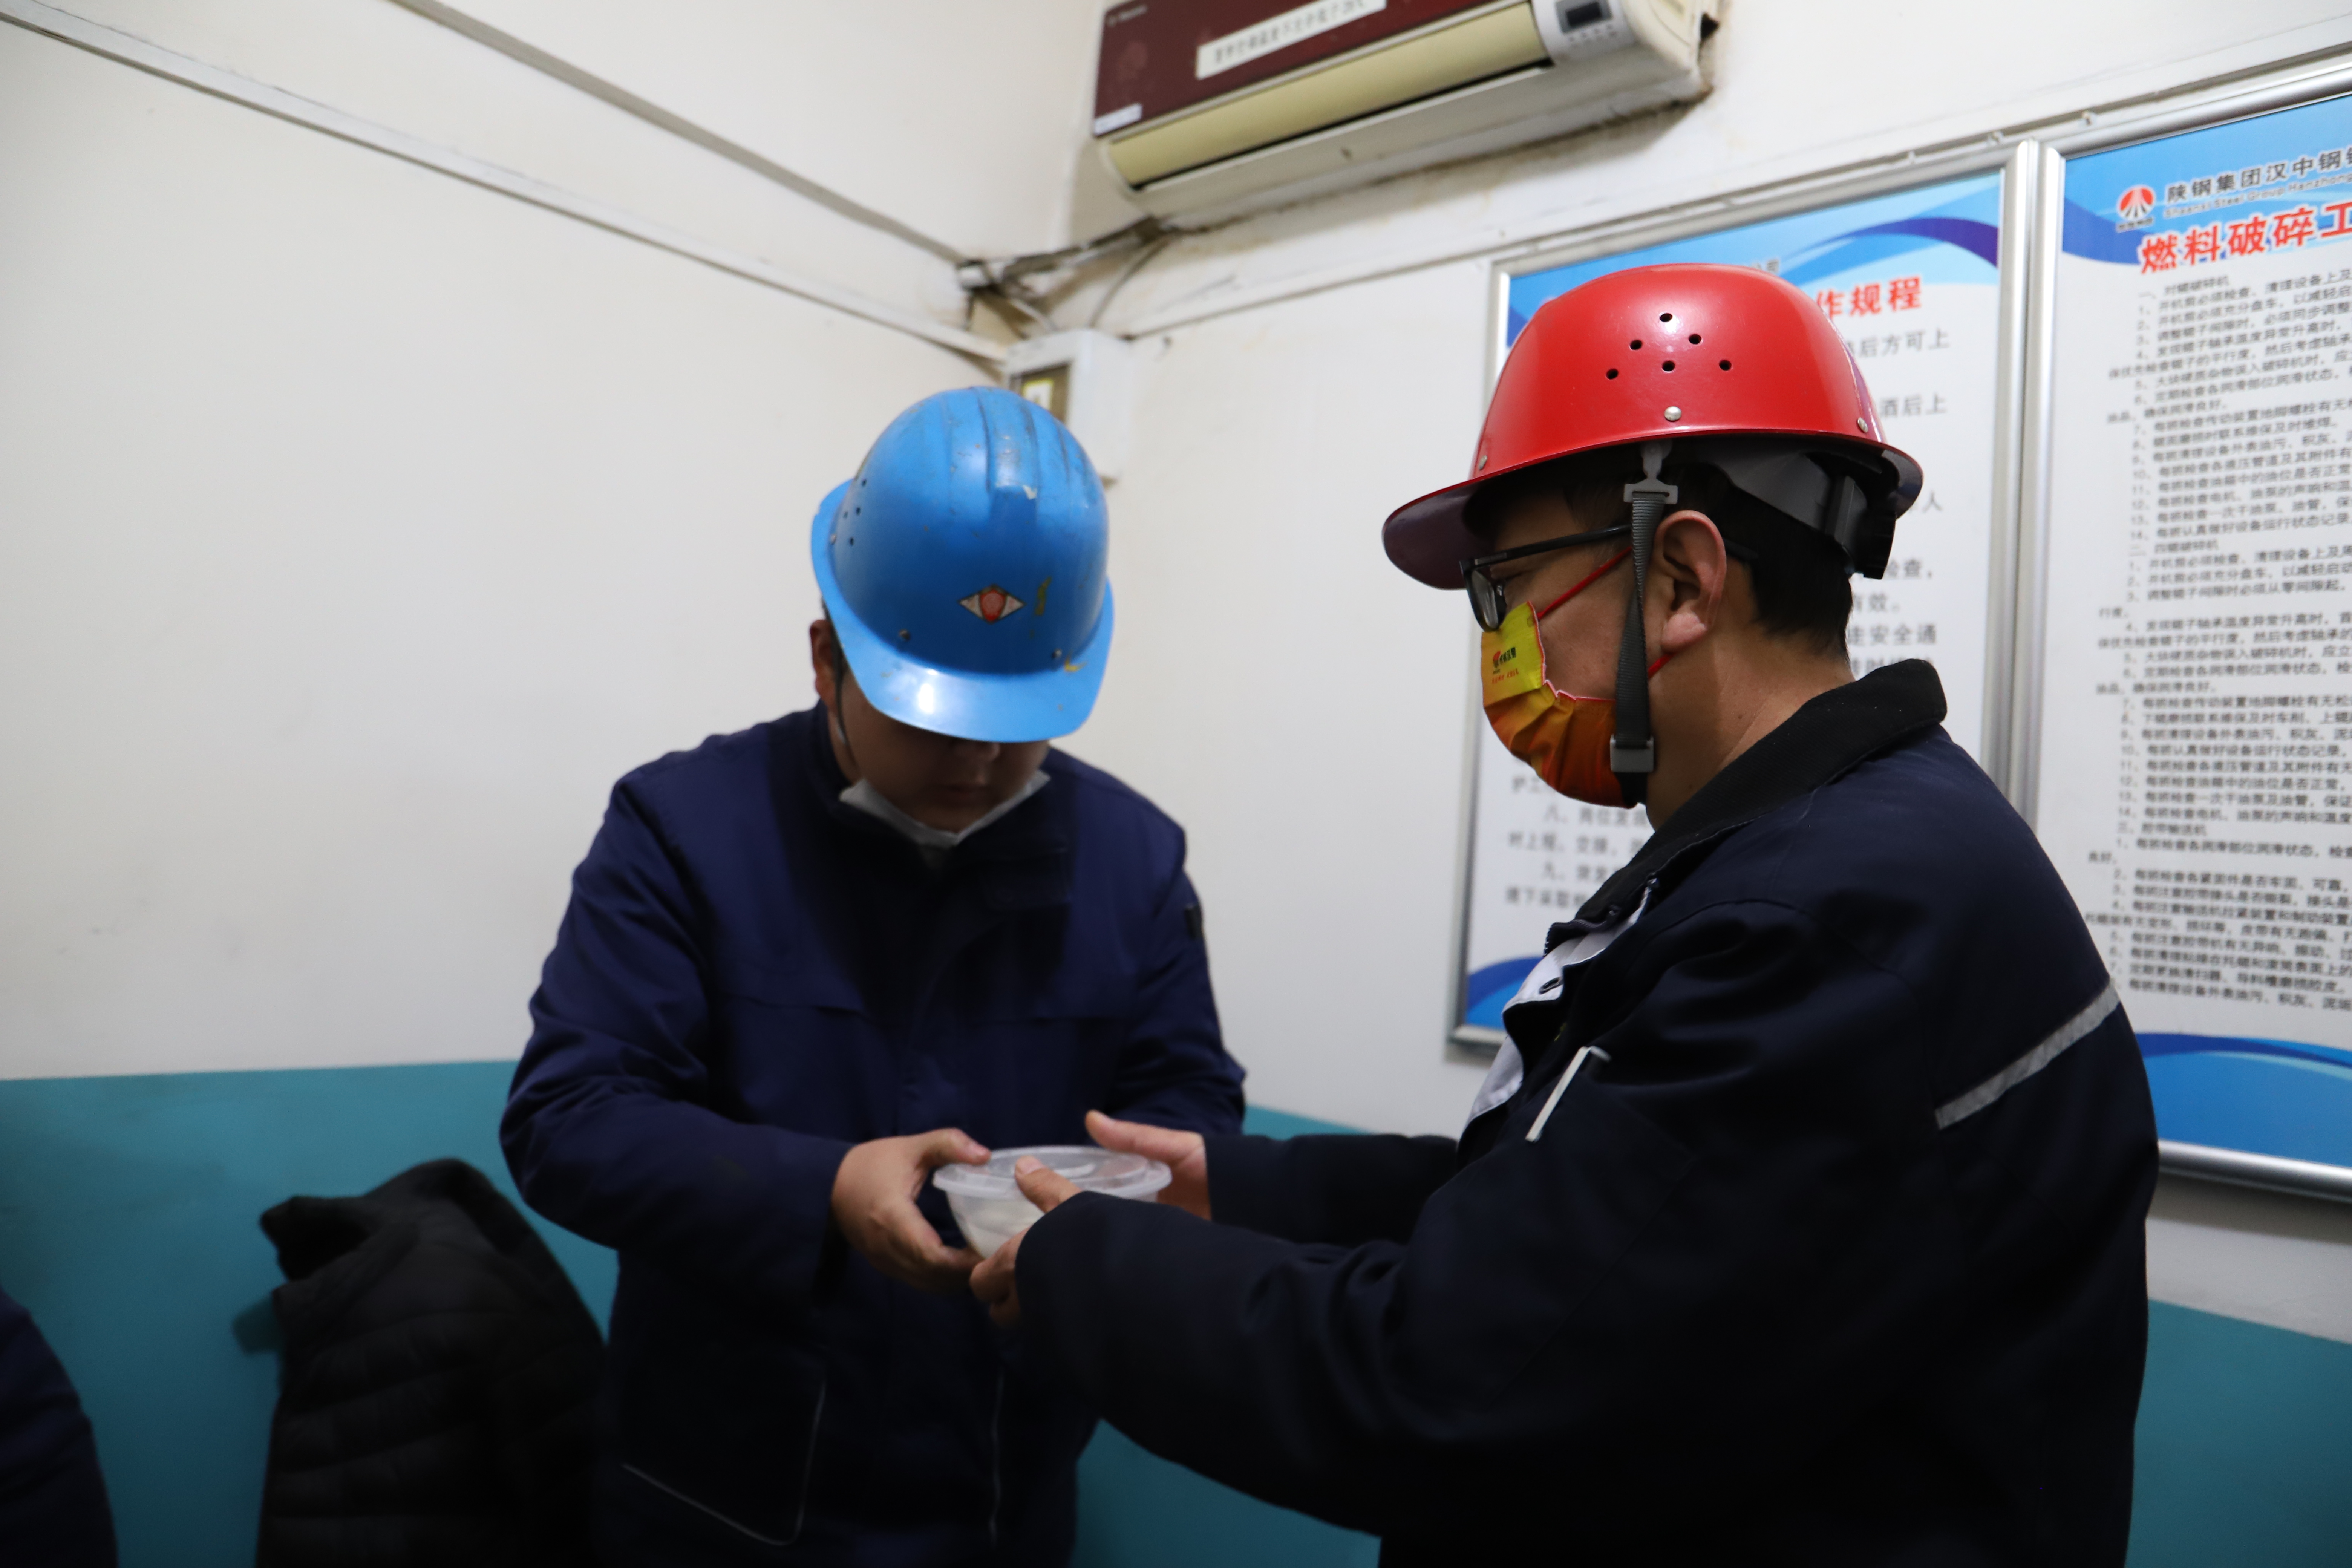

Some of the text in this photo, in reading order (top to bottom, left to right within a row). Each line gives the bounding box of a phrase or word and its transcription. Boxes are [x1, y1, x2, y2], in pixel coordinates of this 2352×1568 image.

[2168, 148, 2352, 204] 陕钢集团汉中钢
[2141, 201, 2352, 274] 燃料破碎工
[1816, 277, 1921, 320] 作规程
